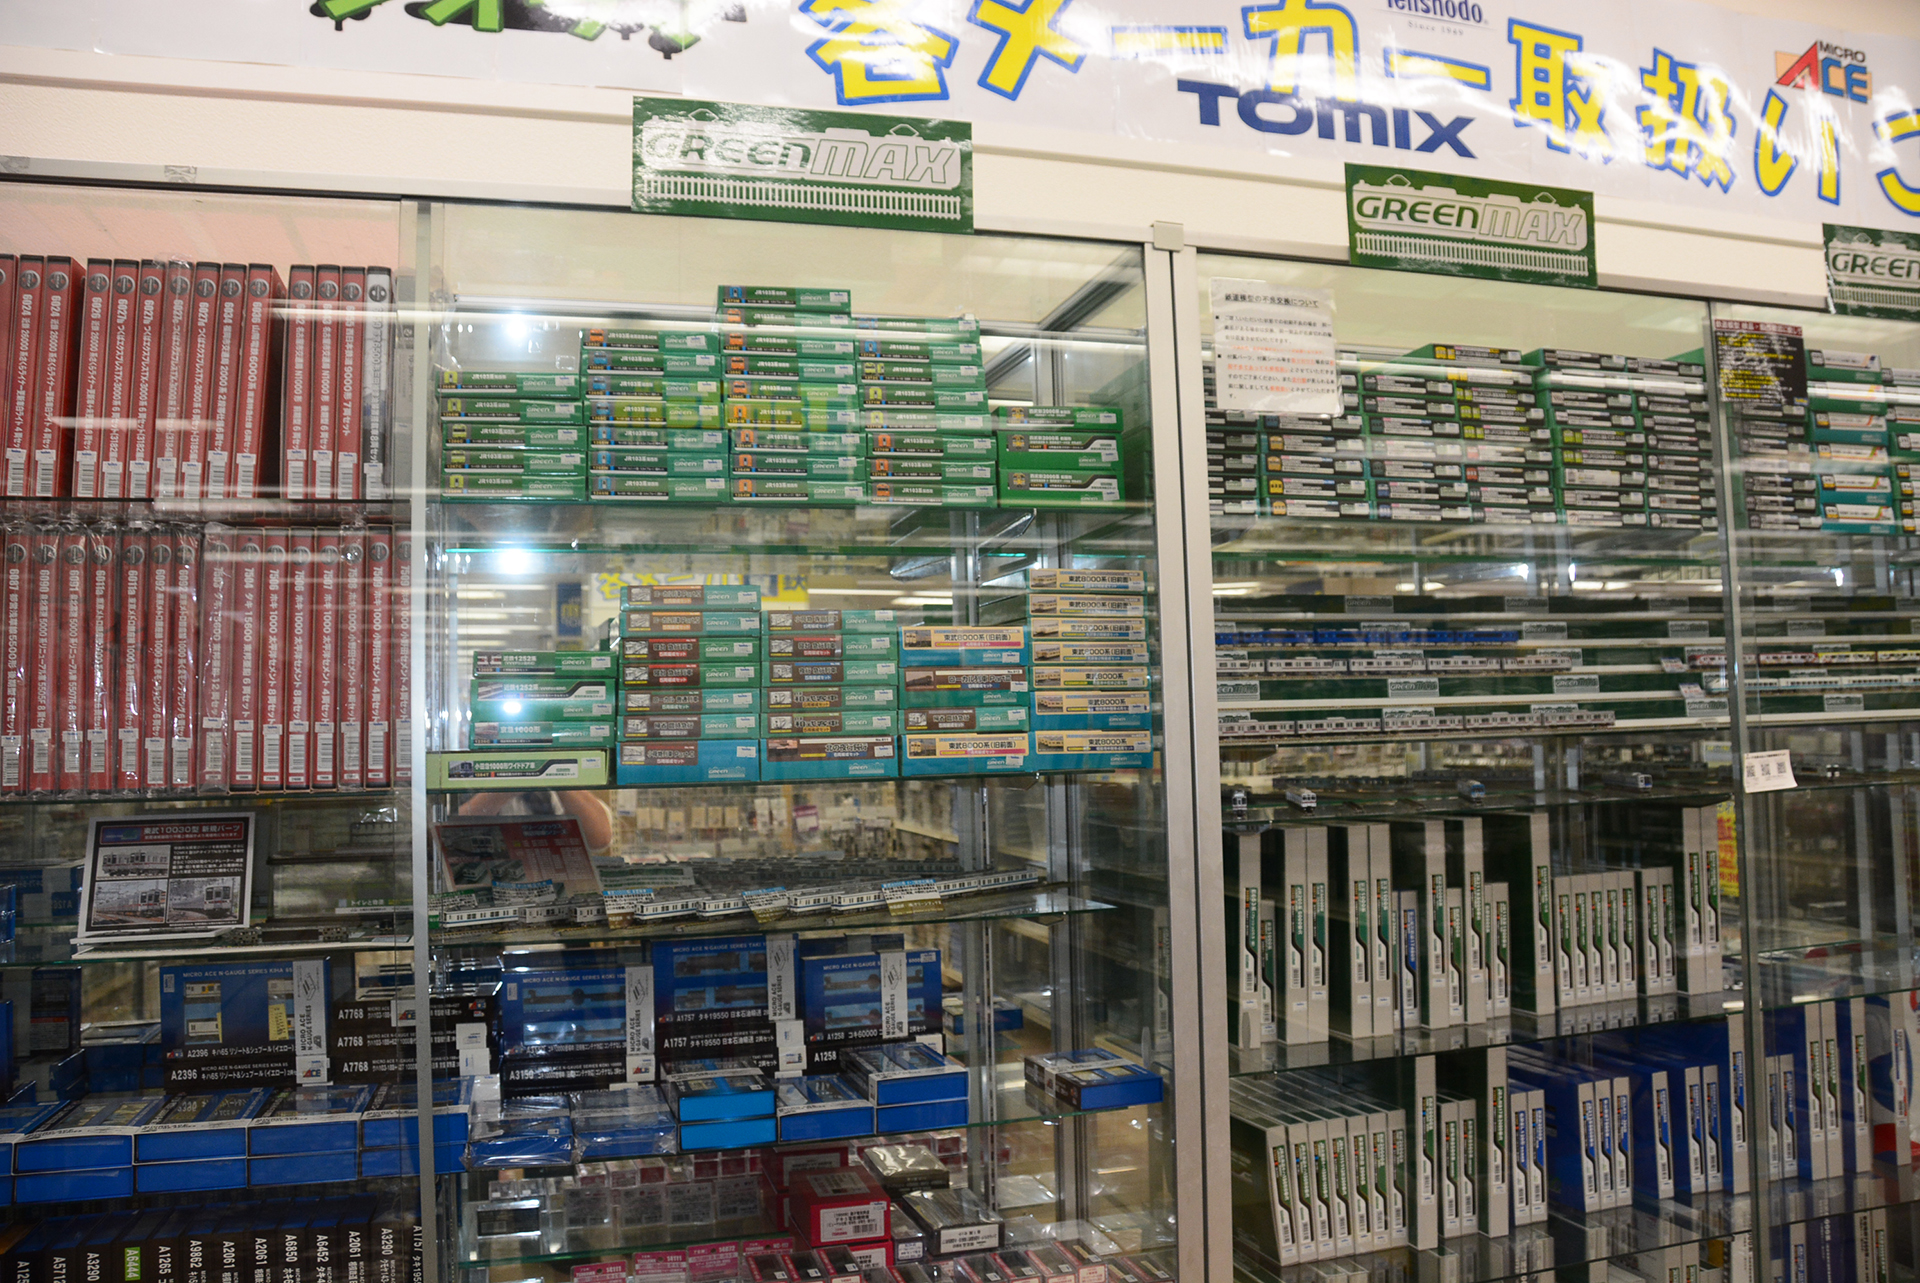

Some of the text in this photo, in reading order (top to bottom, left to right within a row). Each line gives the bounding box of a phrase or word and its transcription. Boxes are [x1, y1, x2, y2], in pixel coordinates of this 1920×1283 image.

[1820, 41, 1867, 62] MICRO
[1776, 42, 1868, 103] ACE
[1177, 78, 1478, 159] TOMIX
[645, 134, 957, 185] GREENMAX
[1356, 194, 1586, 247] GREENMAX
[21, 294, 32, 315] 6024
[50, 295, 61, 316] 6024
[91, 297, 102, 318] 6026
[222, 302, 232, 322] 6034
[9, 568, 19, 590] 6087
[39, 569, 49, 592] 6090
[69, 569, 81, 591] 6091
[156, 568, 164, 591] 6092
[244, 567, 254, 588] 7504
[270, 569, 280, 589] 7506
[323, 570, 333, 589] 7507
[374, 566, 383, 587] 7509
[338, 1008, 364, 1020] A7768
[676, 1014, 695, 1022] A1757
[337, 1036, 364, 1048] A7768
[664, 1037, 687, 1048] A1757
[827, 1032, 845, 1040] A1258
[187, 1049, 208, 1058] A2396
[814, 1052, 837, 1062] A1258
[171, 1069, 198, 1080] A2396
[342, 1061, 368, 1072] A7768
[255, 1238, 268, 1265] A2061
[286, 1234, 298, 1262] A6850
[316, 1234, 328, 1263] A6452
[348, 1230, 360, 1258] A2061
[381, 1228, 393, 1256] A3290
[126, 1249, 140, 1279] A6444
[158, 1246, 172, 1275] A1265
[190, 1240, 202, 1268] A9862
[222, 1241, 236, 1269] A2061
[87, 1252, 100, 1282] A3290
